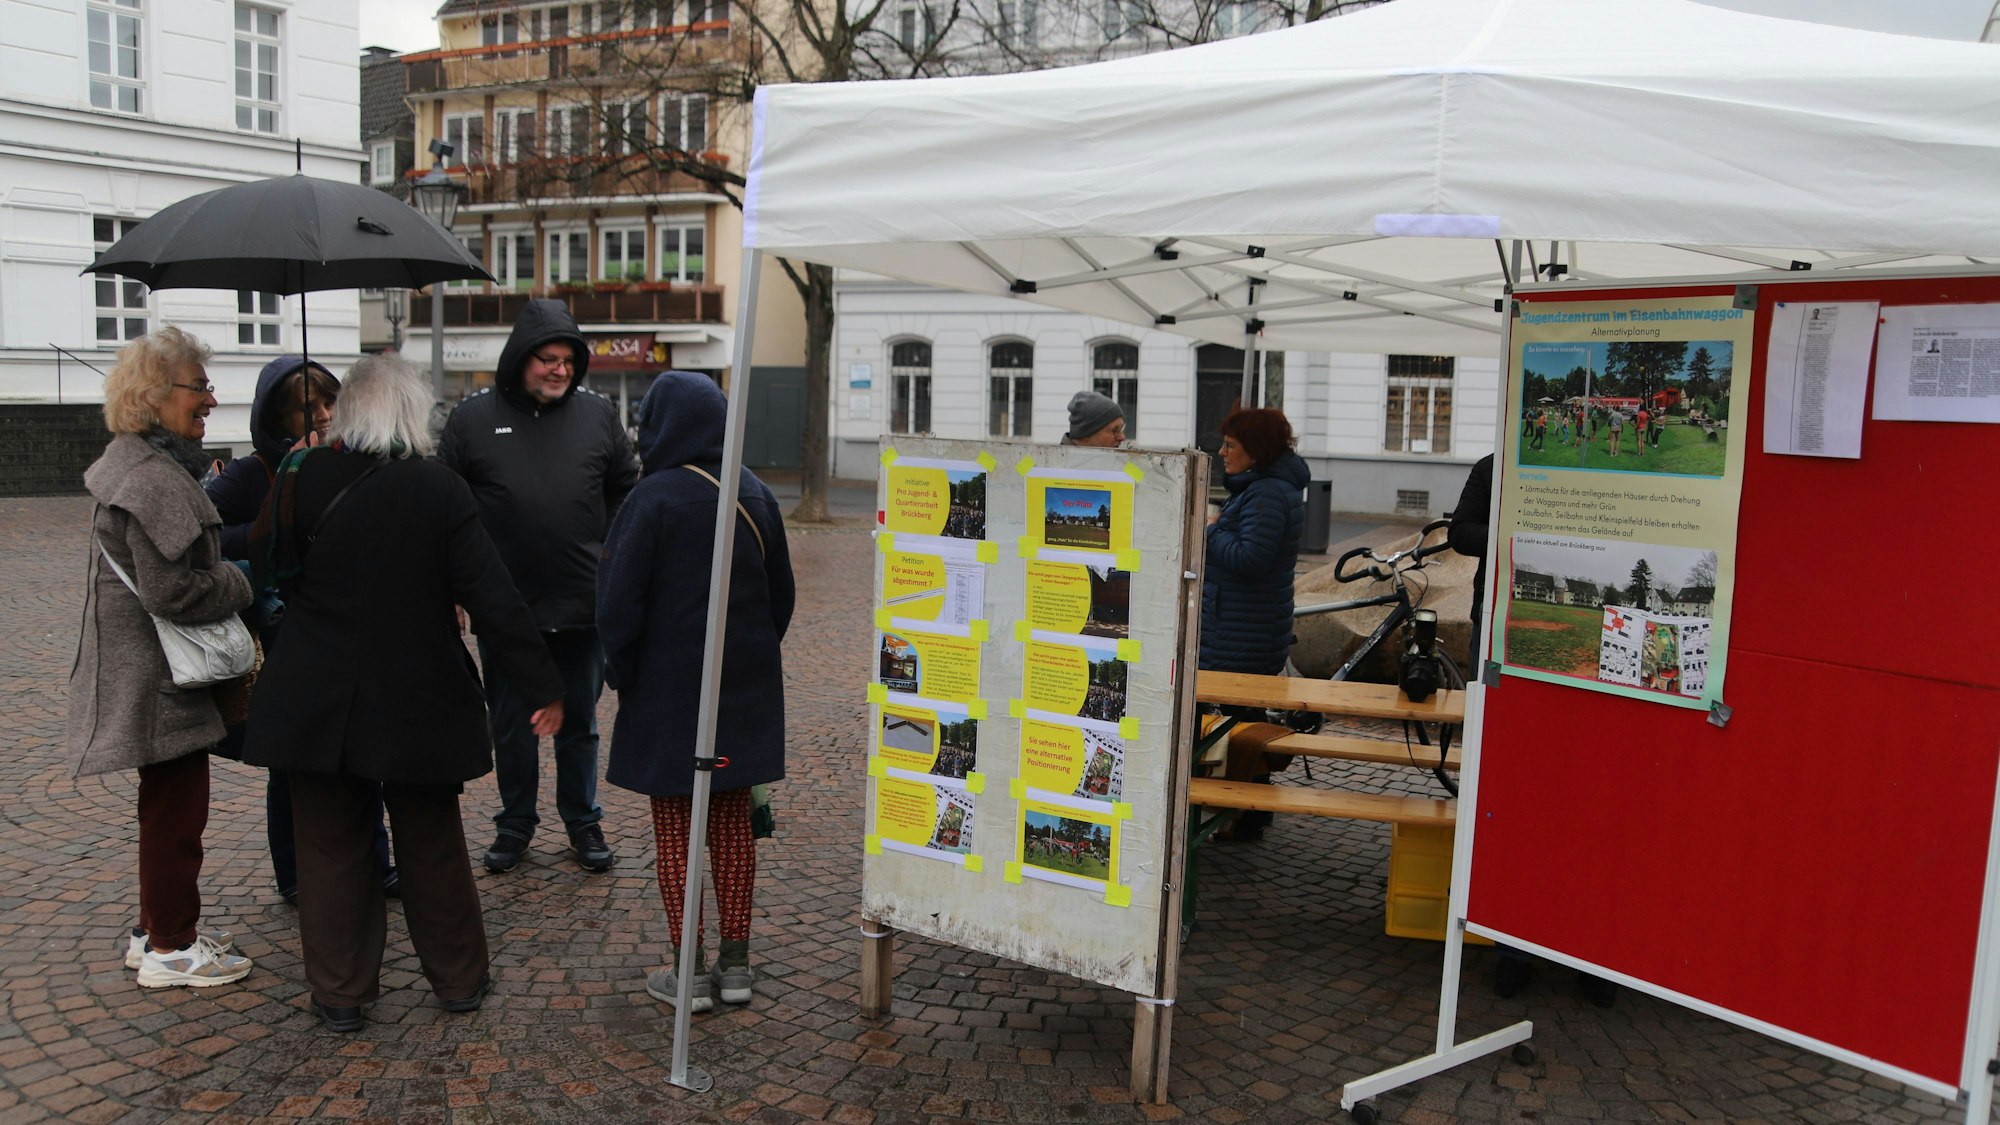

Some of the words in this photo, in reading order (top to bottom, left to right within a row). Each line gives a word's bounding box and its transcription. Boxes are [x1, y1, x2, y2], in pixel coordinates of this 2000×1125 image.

[1520, 312, 1610, 326] Jugendzentrum
[1612, 310, 1627, 321] im
[1630, 308, 1744, 322] Eisenbahnwaggon
[1591, 326, 1660, 338] Alternativplanung
[905, 478, 930, 486] Initiative
[908, 489, 931, 498] Jugend-
[1525, 485, 1559, 496] Lärmschutz
[1560, 486, 1570, 496] für
[1570, 488, 1580, 496] die
[1582, 488, 1622, 500] anliegenden
[1624, 491, 1648, 501] Häuser
[1650, 494, 1668, 502] durch
[1670, 495, 1700, 506] Drehung
[896, 499, 938, 509] Quartierarbeit
[1076, 500, 1092, 508] Platz
[1524, 496, 1534, 504] der
[1536, 498, 1566, 509] Waggons
[1568, 500, 1580, 508] und
[1582, 502, 1598, 510] mehr
[1600, 502, 1616, 511] Grün
[901, 510, 932, 520] Brückberg
[1523, 508, 1552, 519] Laufbahn,
[1556, 511, 1584, 520] Seilbahn
[1585, 512, 1598, 522] und
[1599, 514, 1643, 526] Kleinspielfeld
[1644, 518, 1670, 528] bleiben
[1671, 520, 1700, 530] erhalten
[1522, 520, 1552, 531] Waggons
[1554, 524, 1576, 532] werten
[1578, 525, 1590, 534] das
[1592, 526, 1620, 536] Gelände
[1622, 528, 1634, 537] auf
[1568, 540, 1595, 552] Brückberg
[902, 556, 924, 565] Petition
[892, 577, 928, 586] abgestimmt
[1039, 739, 1056, 748] sehen
[1058, 740, 1071, 750] hier
[1040, 750, 1072, 762] alternative
[1027, 758, 1071, 774] Positionierung
